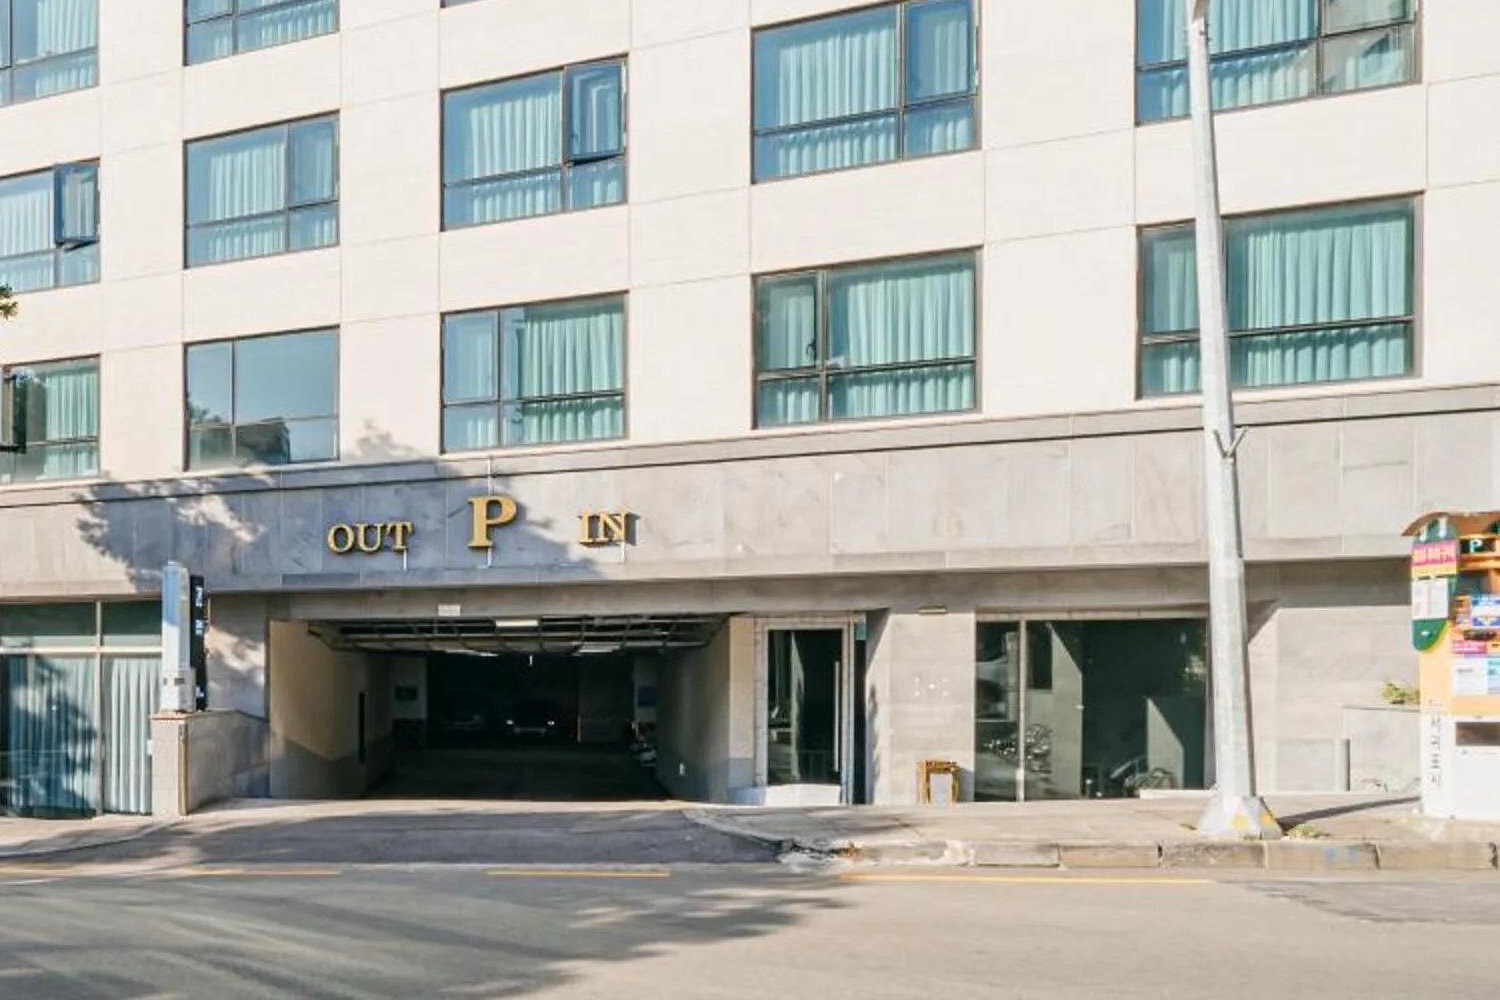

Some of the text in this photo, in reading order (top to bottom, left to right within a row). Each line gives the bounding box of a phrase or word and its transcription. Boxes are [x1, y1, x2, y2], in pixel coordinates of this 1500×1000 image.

[327, 495, 630, 553] OUT P IN
